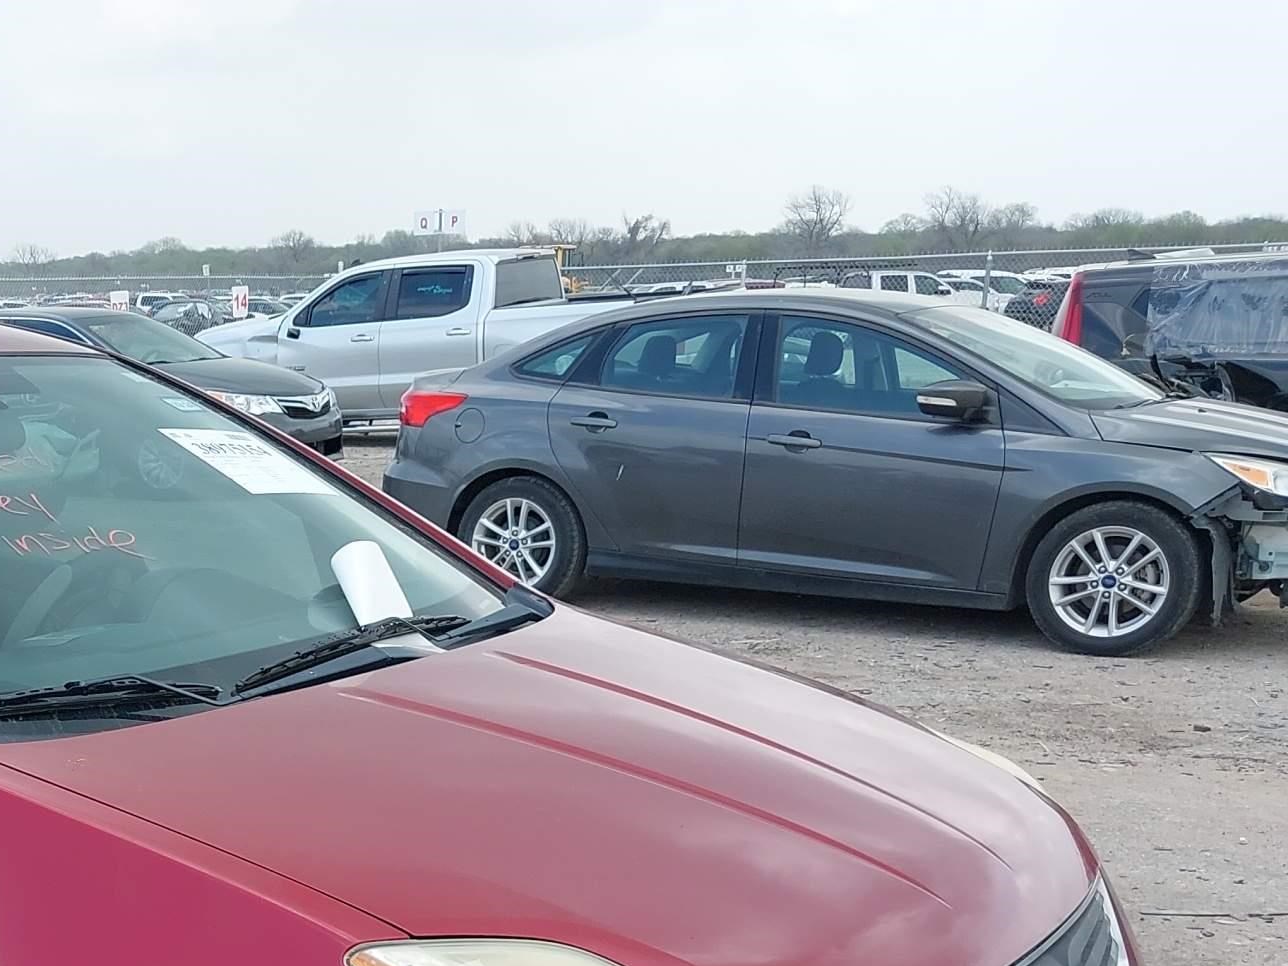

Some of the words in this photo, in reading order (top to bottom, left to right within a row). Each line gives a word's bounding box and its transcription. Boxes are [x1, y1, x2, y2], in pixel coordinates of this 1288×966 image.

[420, 217, 428, 229] Q
[451, 215, 458, 227] P
[233, 294, 248, 310] 14
